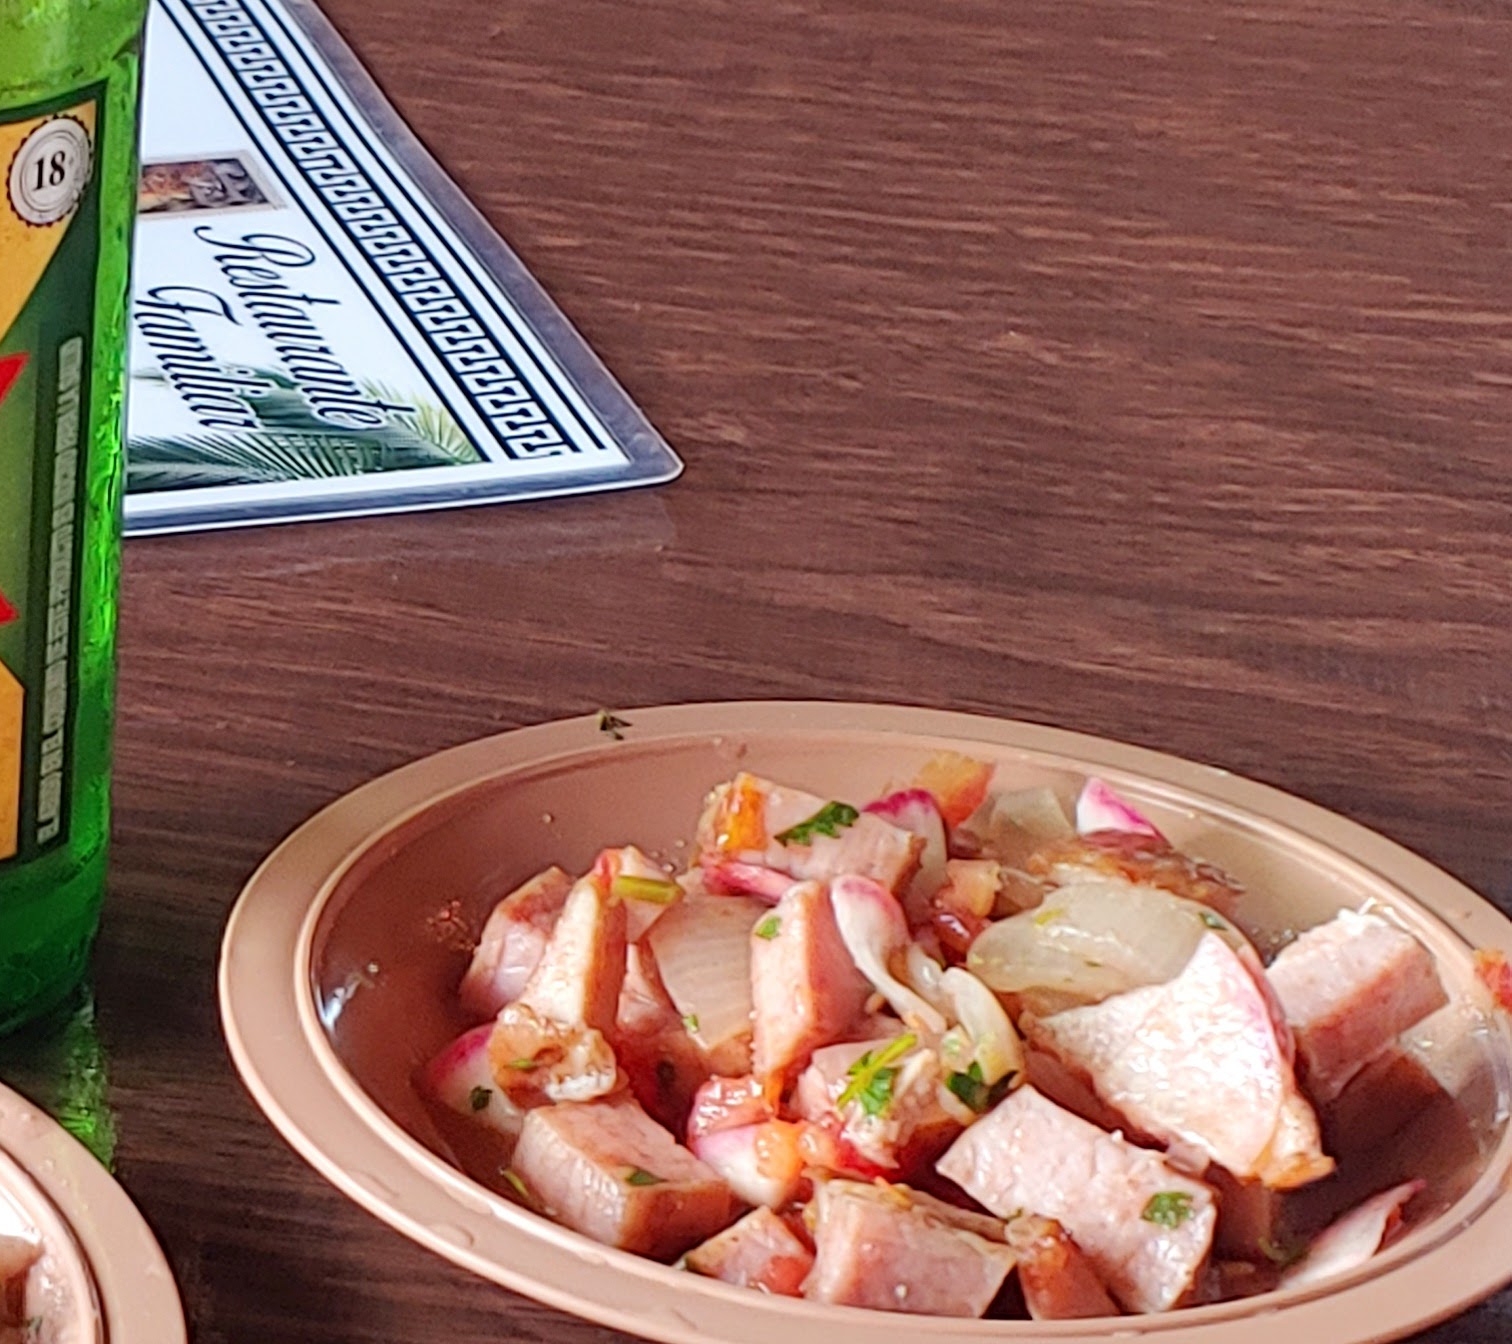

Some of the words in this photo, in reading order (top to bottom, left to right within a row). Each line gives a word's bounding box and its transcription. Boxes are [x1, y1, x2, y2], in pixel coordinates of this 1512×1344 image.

[32, 150, 66, 191] 18
[134, 284, 275, 434] Familiar
[193, 224, 420, 432] Restaurante
